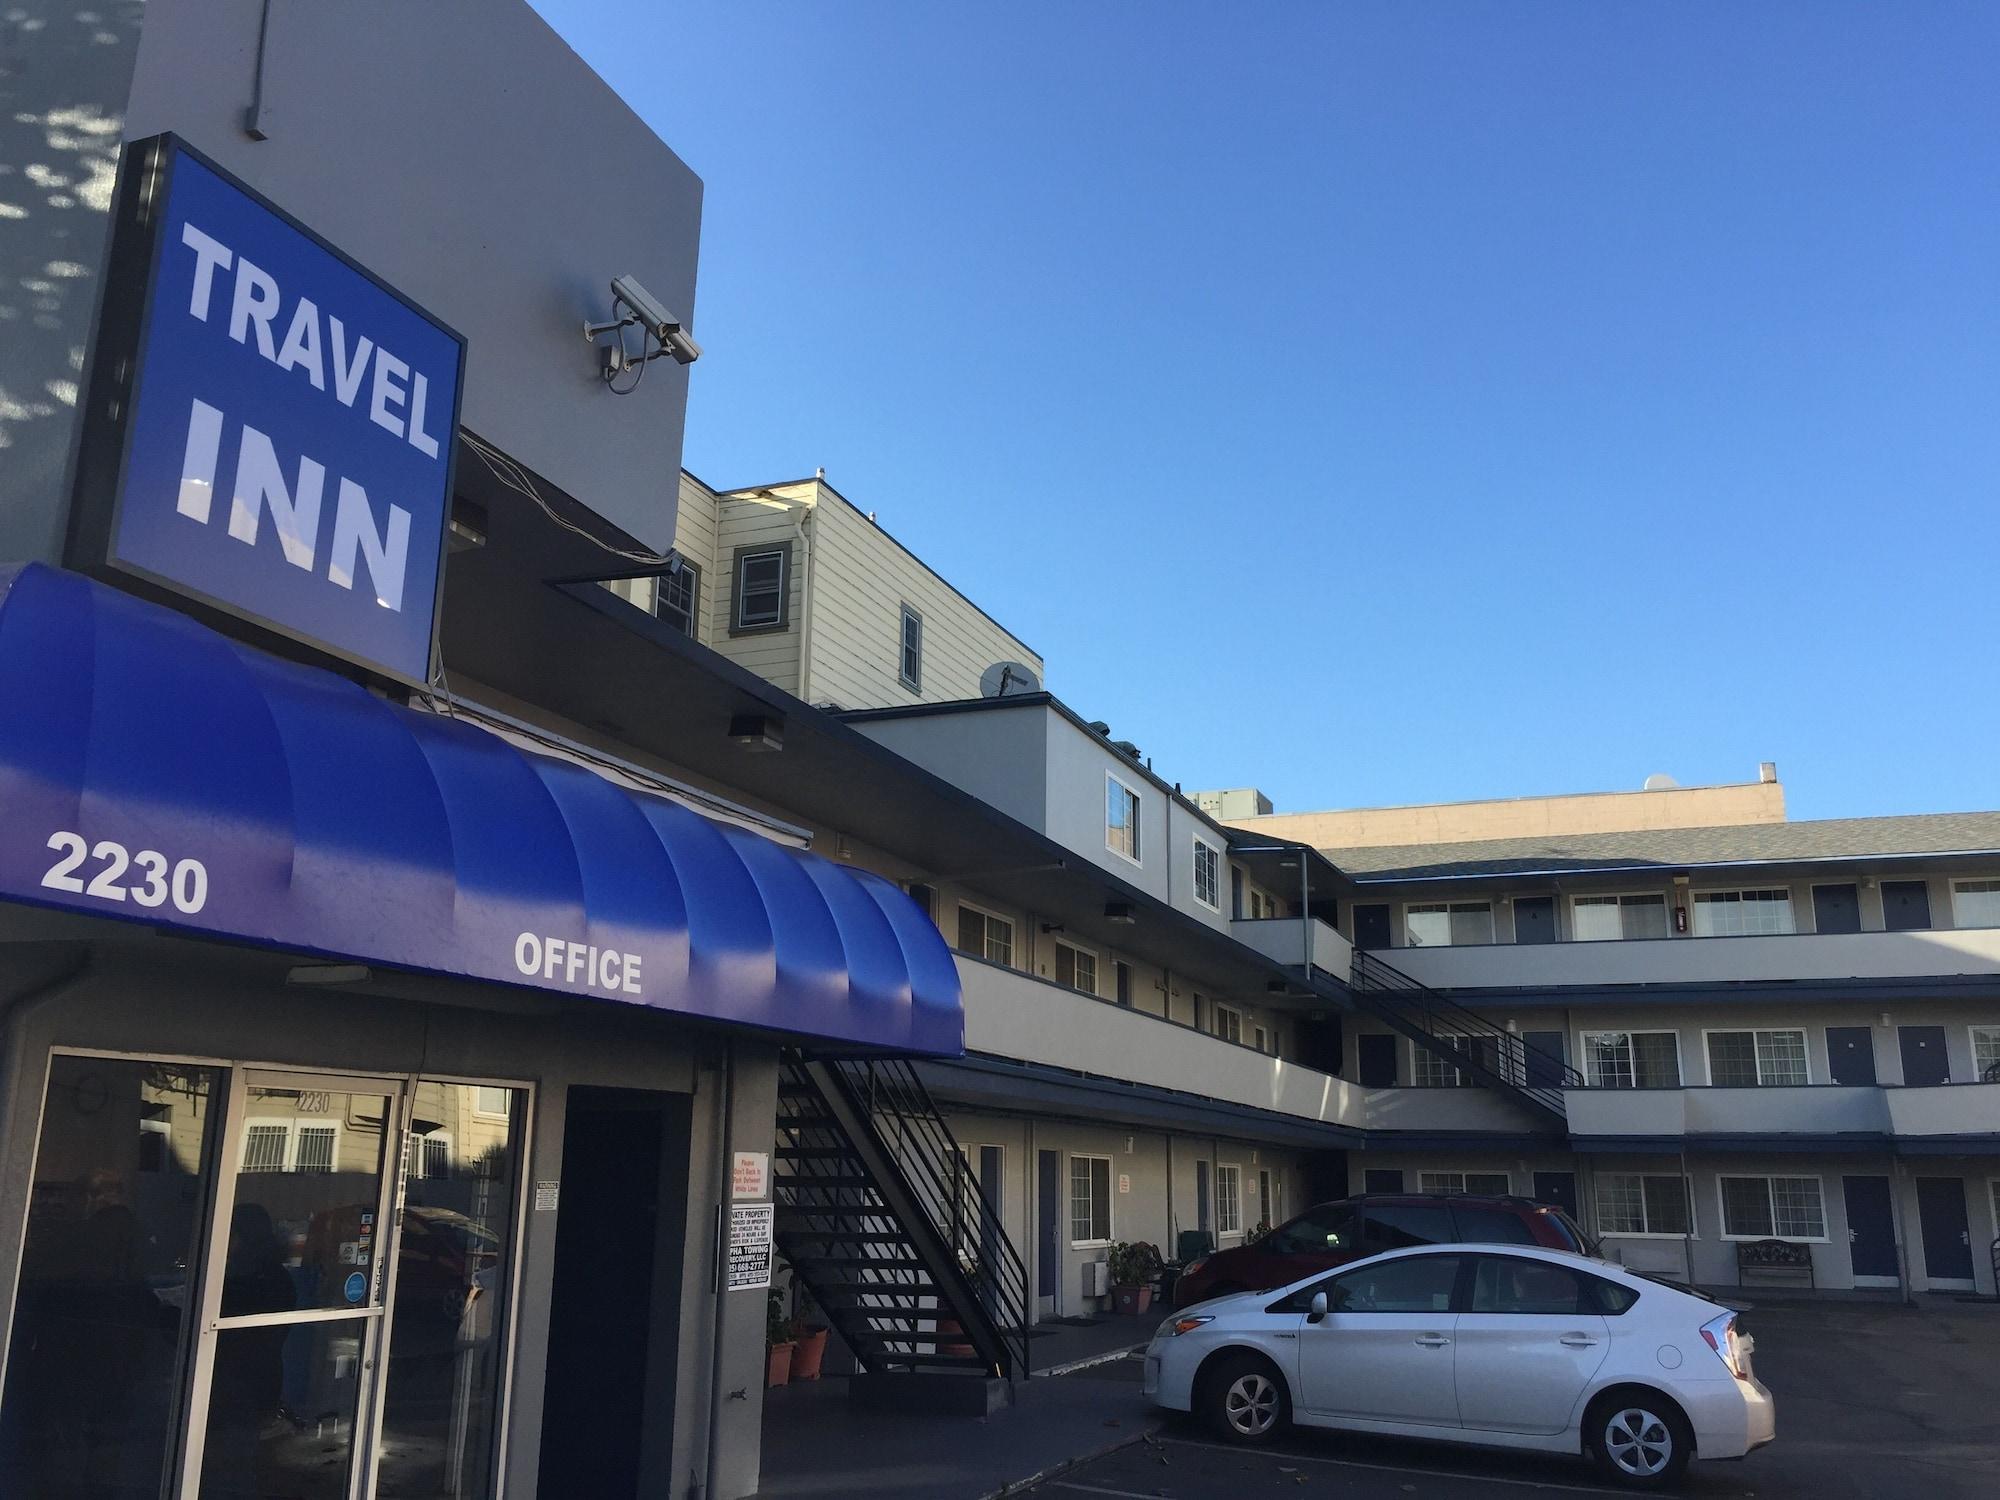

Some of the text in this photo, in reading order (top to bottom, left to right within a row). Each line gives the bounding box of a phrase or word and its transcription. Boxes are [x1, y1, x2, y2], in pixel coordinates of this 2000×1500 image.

[181, 221, 439, 460] TRAVEL
[176, 397, 412, 613] INN
[40, 831, 208, 914] 2230
[514, 931, 642, 994] OFFICE
[300, 1091, 330, 1113] 2230
[731, 1210, 770, 1219] VATE PROPERTY
[730, 1245, 768, 1255] PHA TOWING
[757, 1253, 767, 1261] LLC
